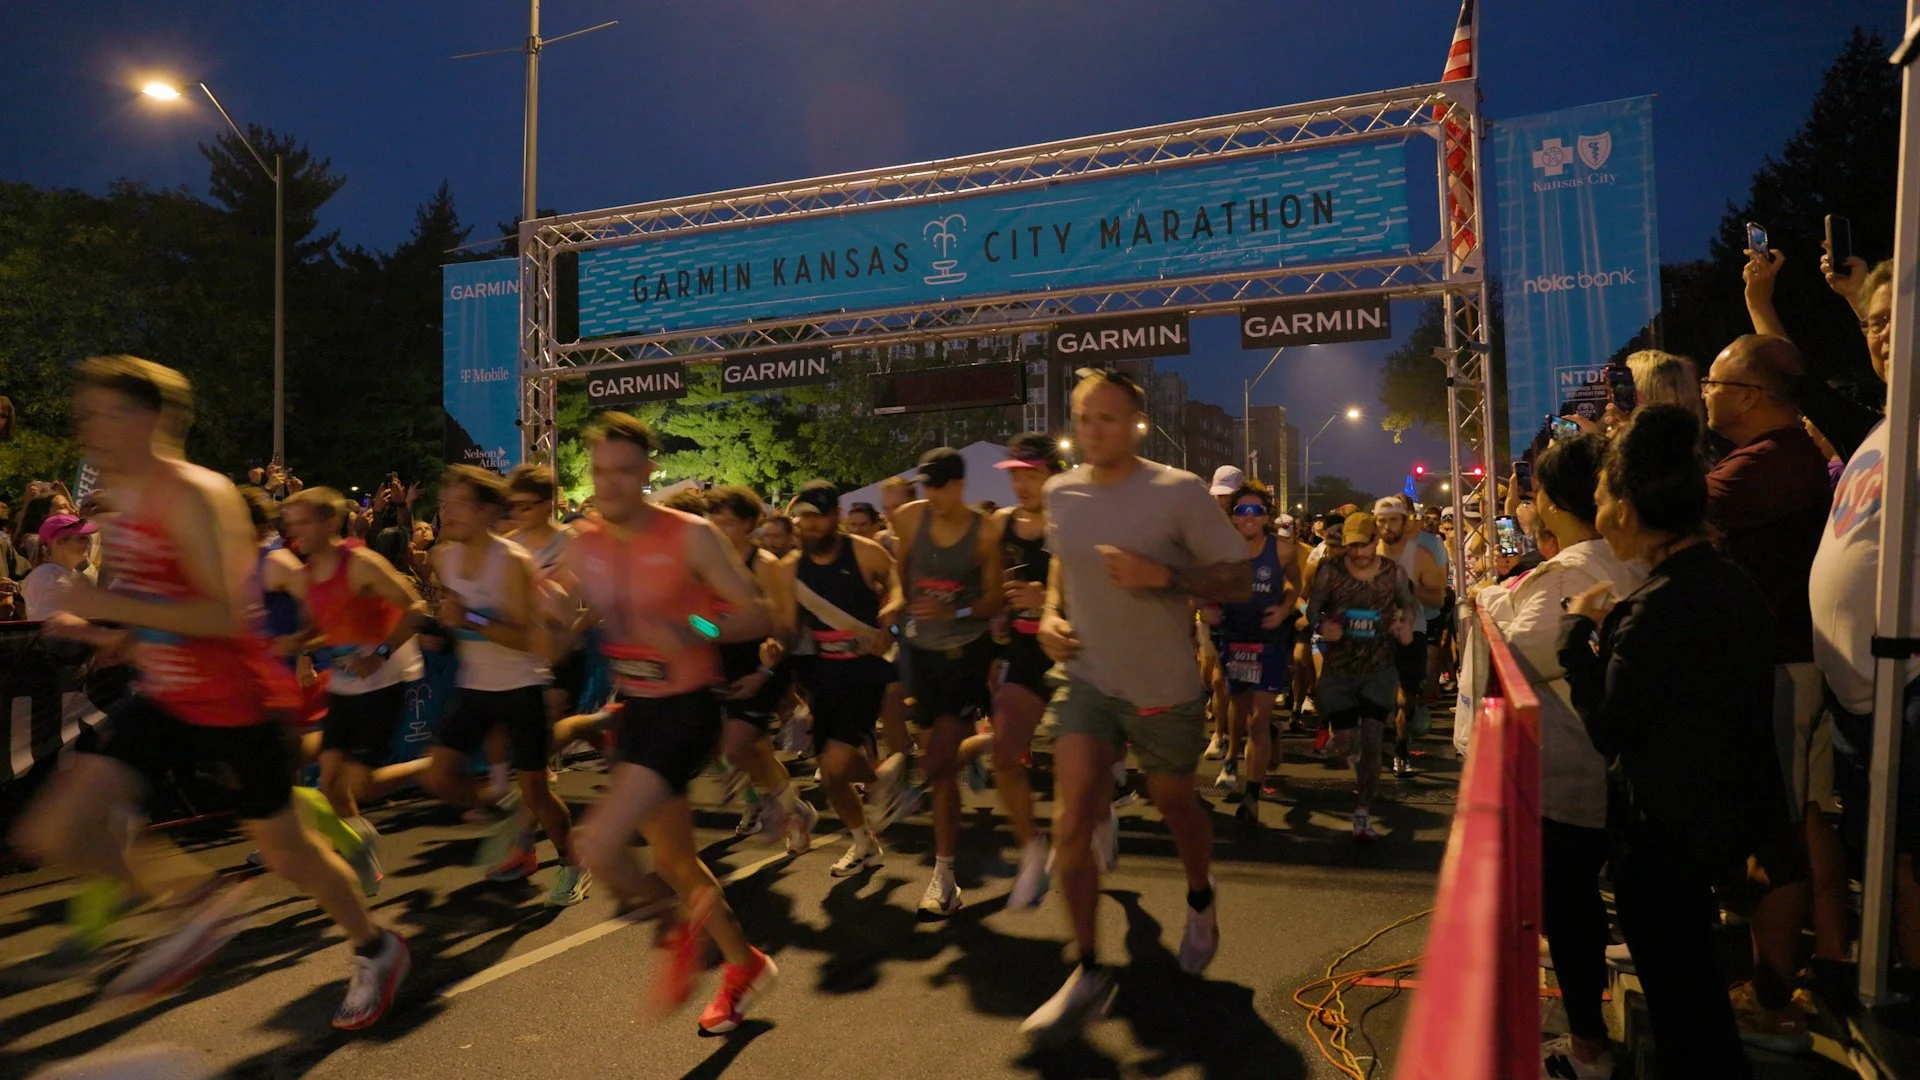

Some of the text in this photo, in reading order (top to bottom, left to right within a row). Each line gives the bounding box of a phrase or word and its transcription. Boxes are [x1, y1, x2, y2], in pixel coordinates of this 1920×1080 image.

[1533, 172, 1617, 192] Kansas City
[633, 191, 1333, 303] GARMIN KANSAS CITY MARATHON
[451, 279, 519, 300] GARMIN
[1523, 266, 1636, 294] nbkc bank
[1244, 307, 1381, 338] GARMIN
[1057, 324, 1181, 353] GARMIN
[473, 366, 509, 383] Mobile
[724, 357, 826, 383] GARMIN
[589, 372, 680, 398] GARMIN
[463, 449, 497, 459] Nelson
[480, 457, 510, 468] Atkins
[1839, 468, 1882, 513] KC
[1234, 651, 1257, 661] 6018
